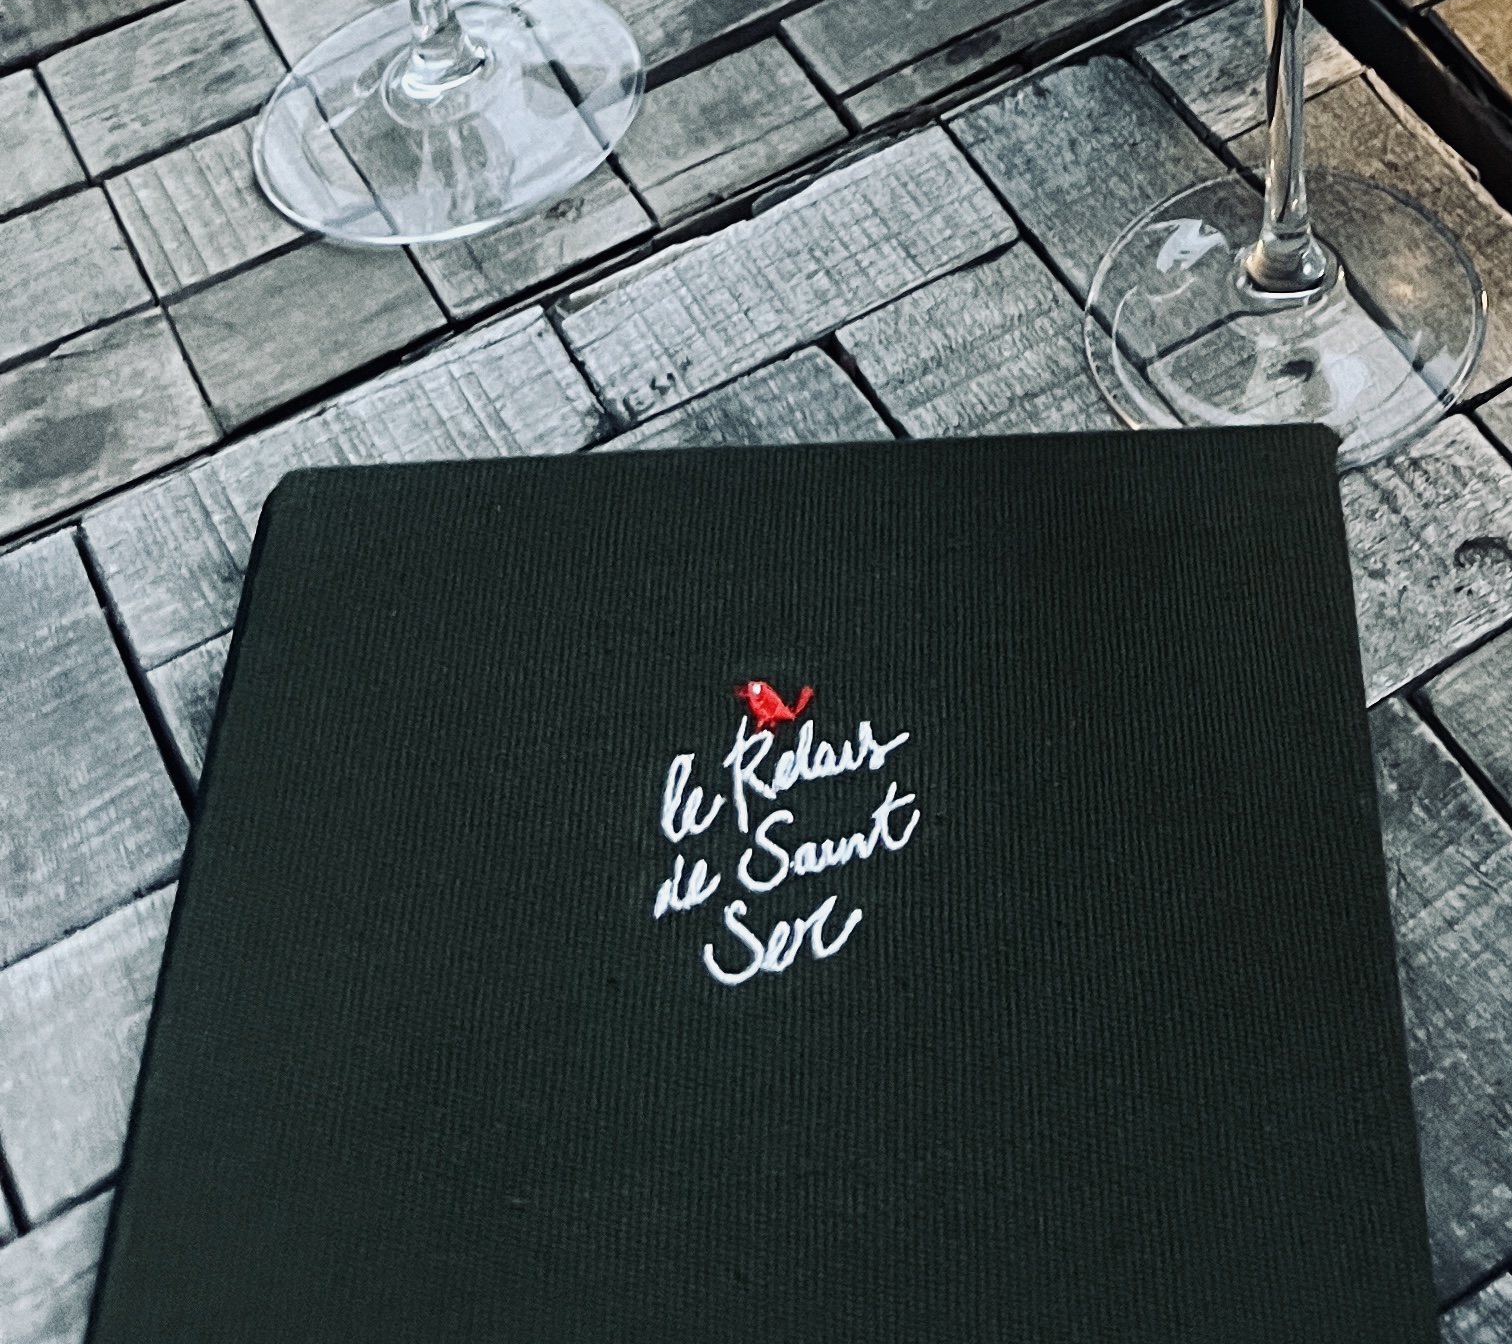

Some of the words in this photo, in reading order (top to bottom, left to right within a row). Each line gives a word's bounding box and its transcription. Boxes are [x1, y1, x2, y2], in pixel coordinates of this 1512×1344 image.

[661, 753, 725, 842] le
[724, 715, 910, 833] Relais
[653, 854, 721, 919] de
[737, 781, 920, 892] Saint
[703, 895, 863, 986] Ser
